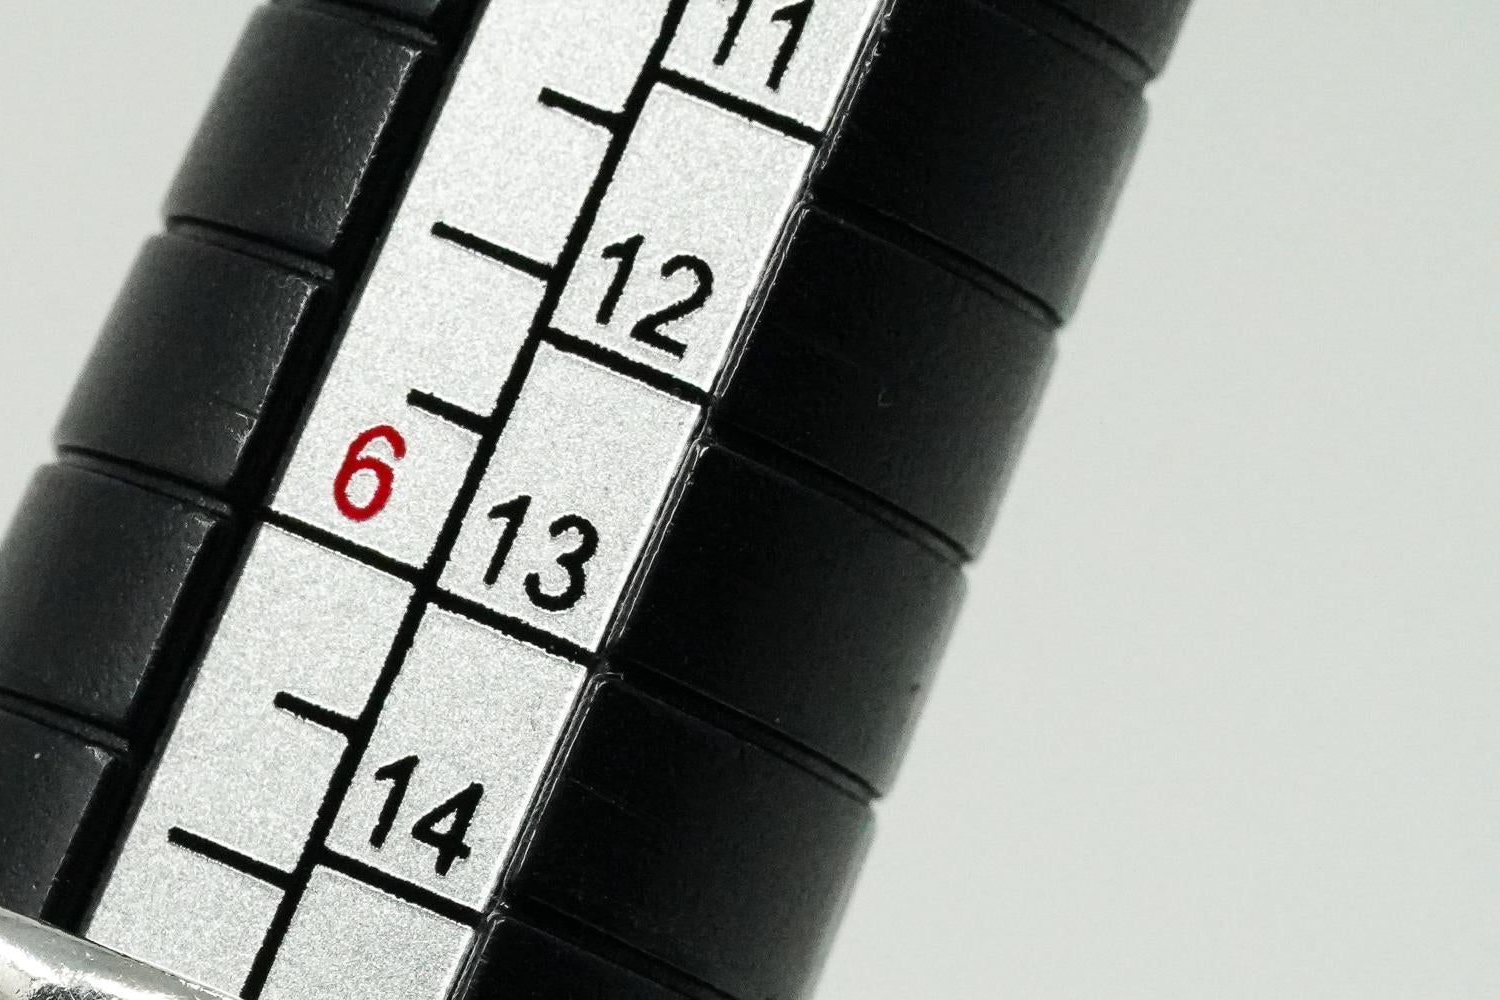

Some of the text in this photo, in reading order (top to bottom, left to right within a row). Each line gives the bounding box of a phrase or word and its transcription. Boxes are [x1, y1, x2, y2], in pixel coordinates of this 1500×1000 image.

[713, 0, 814, 91] 11
[596, 234, 713, 359] 12
[334, 425, 406, 522] 6
[483, 496, 599, 612] 13
[369, 756, 484, 876] 14
